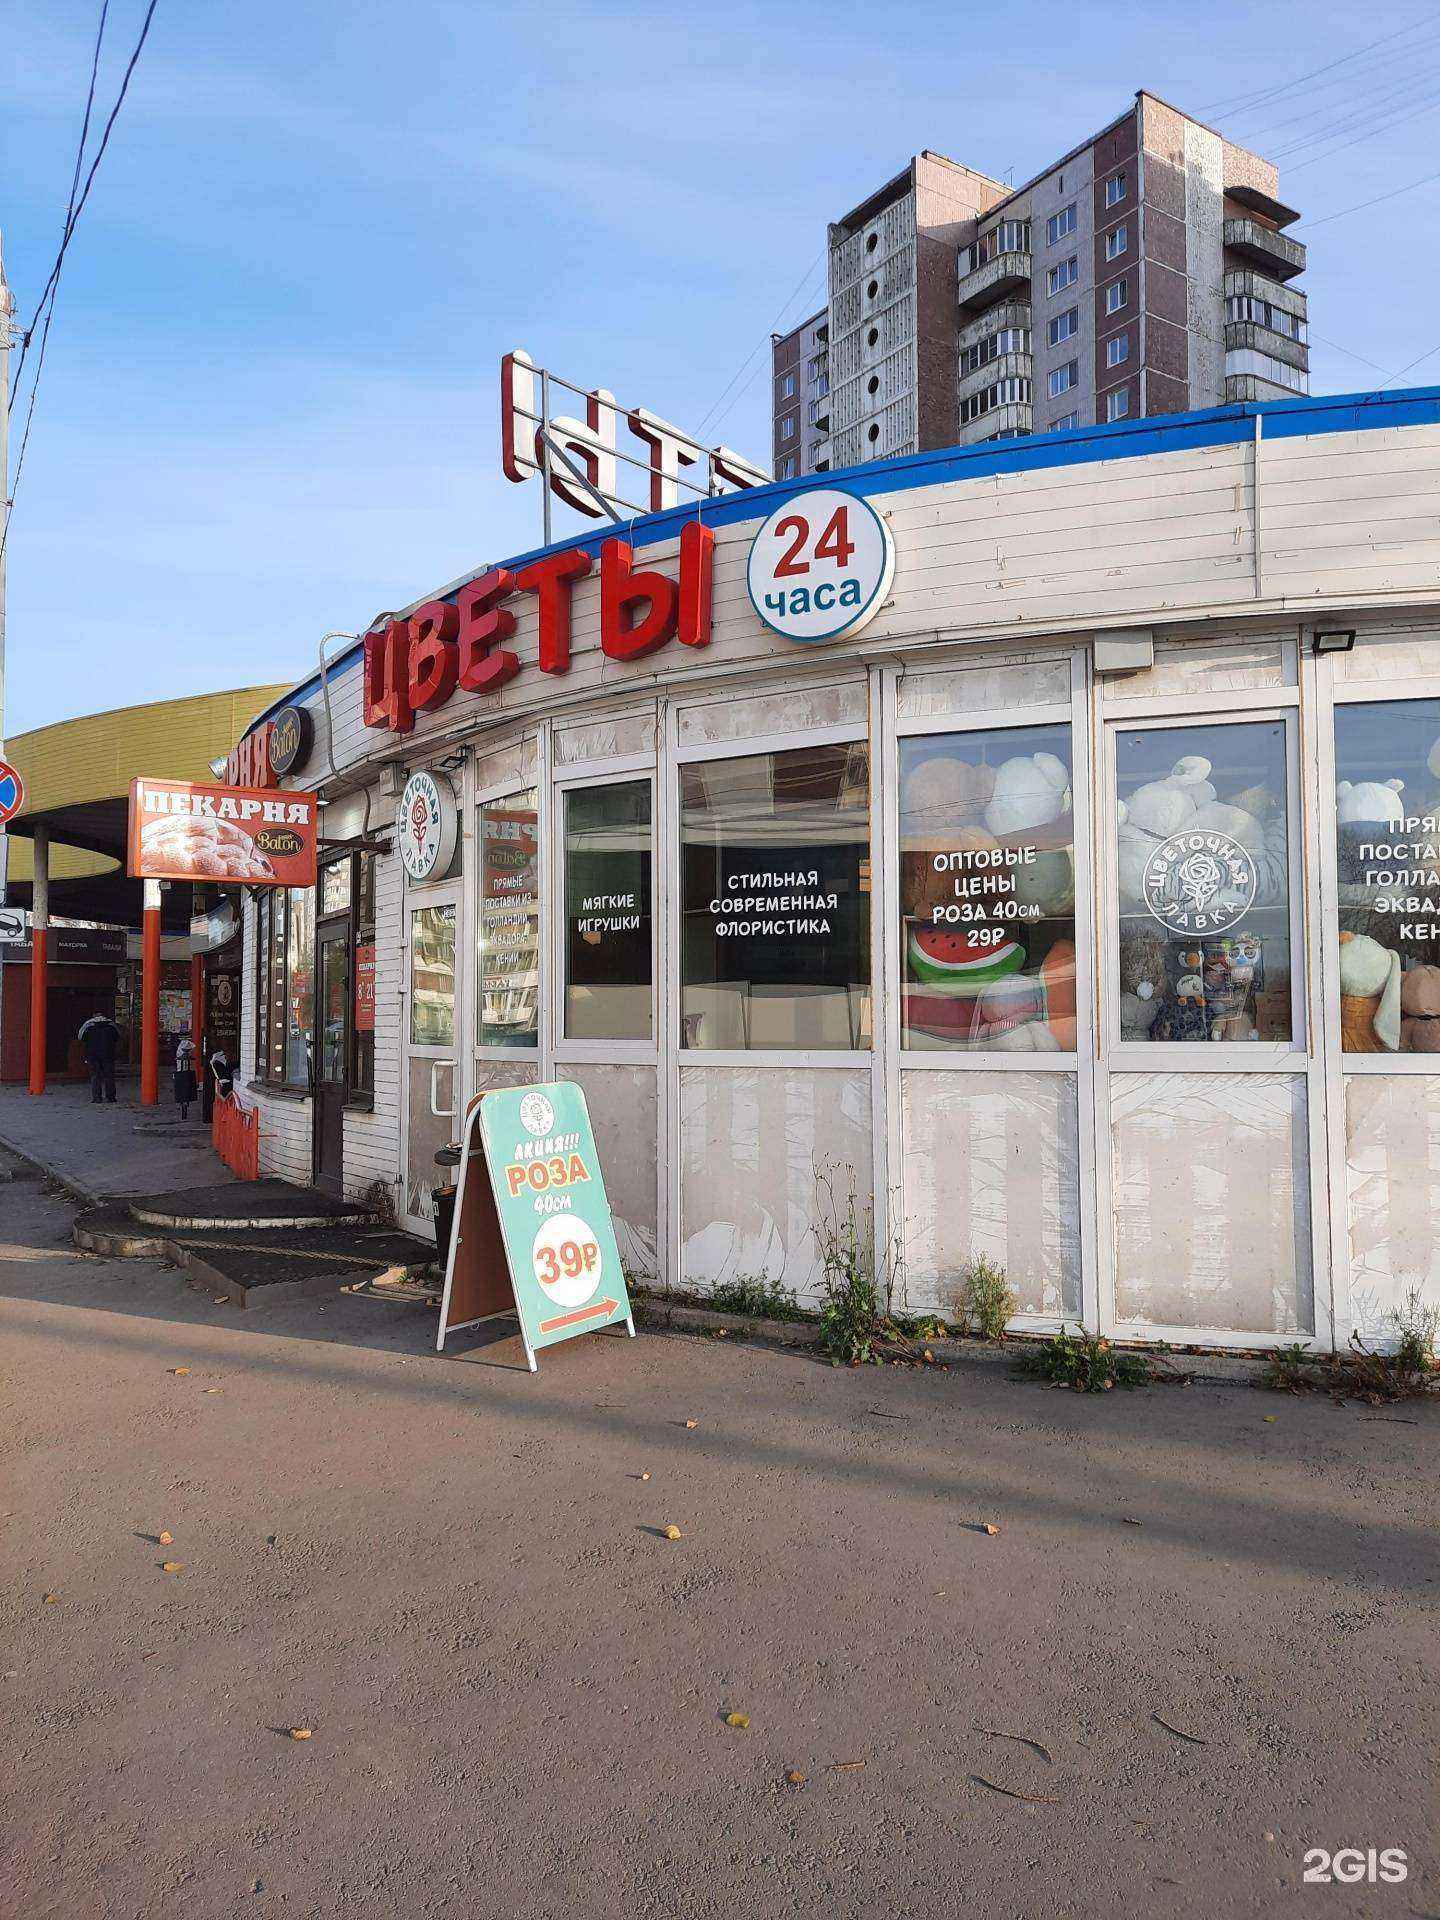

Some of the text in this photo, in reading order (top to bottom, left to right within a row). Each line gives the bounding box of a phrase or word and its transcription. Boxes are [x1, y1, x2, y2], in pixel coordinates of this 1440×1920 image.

[774, 506, 855, 578] 24
[765, 578, 861, 617] часа
[363, 521, 715, 734] ЦВЕТЫ
[143, 791, 310, 825] ПЕКАРНЯ
[400, 776, 439, 834] ЦВЕТОЧНАЯ
[1388, 816, 1440, 834] ПРЯ
[257, 831, 302, 852] Baton
[1359, 843, 1440, 860] ПОСТА
[405, 843, 435, 873] ЛАВКА
[933, 845, 1037, 872] ОПТОВЫЕ
[1149, 835, 1249, 888] ЦВЕТОЧНАЯ
[493, 874, 523, 891] ПРЯМЫЕ
[727, 870, 818, 889] СТИЛЬНАЯ
[954, 874, 1016, 898] ЦЕНЫ
[582, 893, 635, 911] МЯГКИЕ
[709, 893, 838, 913] СОВРЕМЕННАЯ
[932, 900, 1040, 925] РОЗА 40см
[1374, 896, 1440, 915] ЭКВА
[578, 915, 640, 933] ИГРУШКИ
[1161, 900, 1239, 929] ЛАВКА
[715, 918, 831, 936] ФЛОРИСТИКА
[507, 1154, 591, 1196] РОЗА
